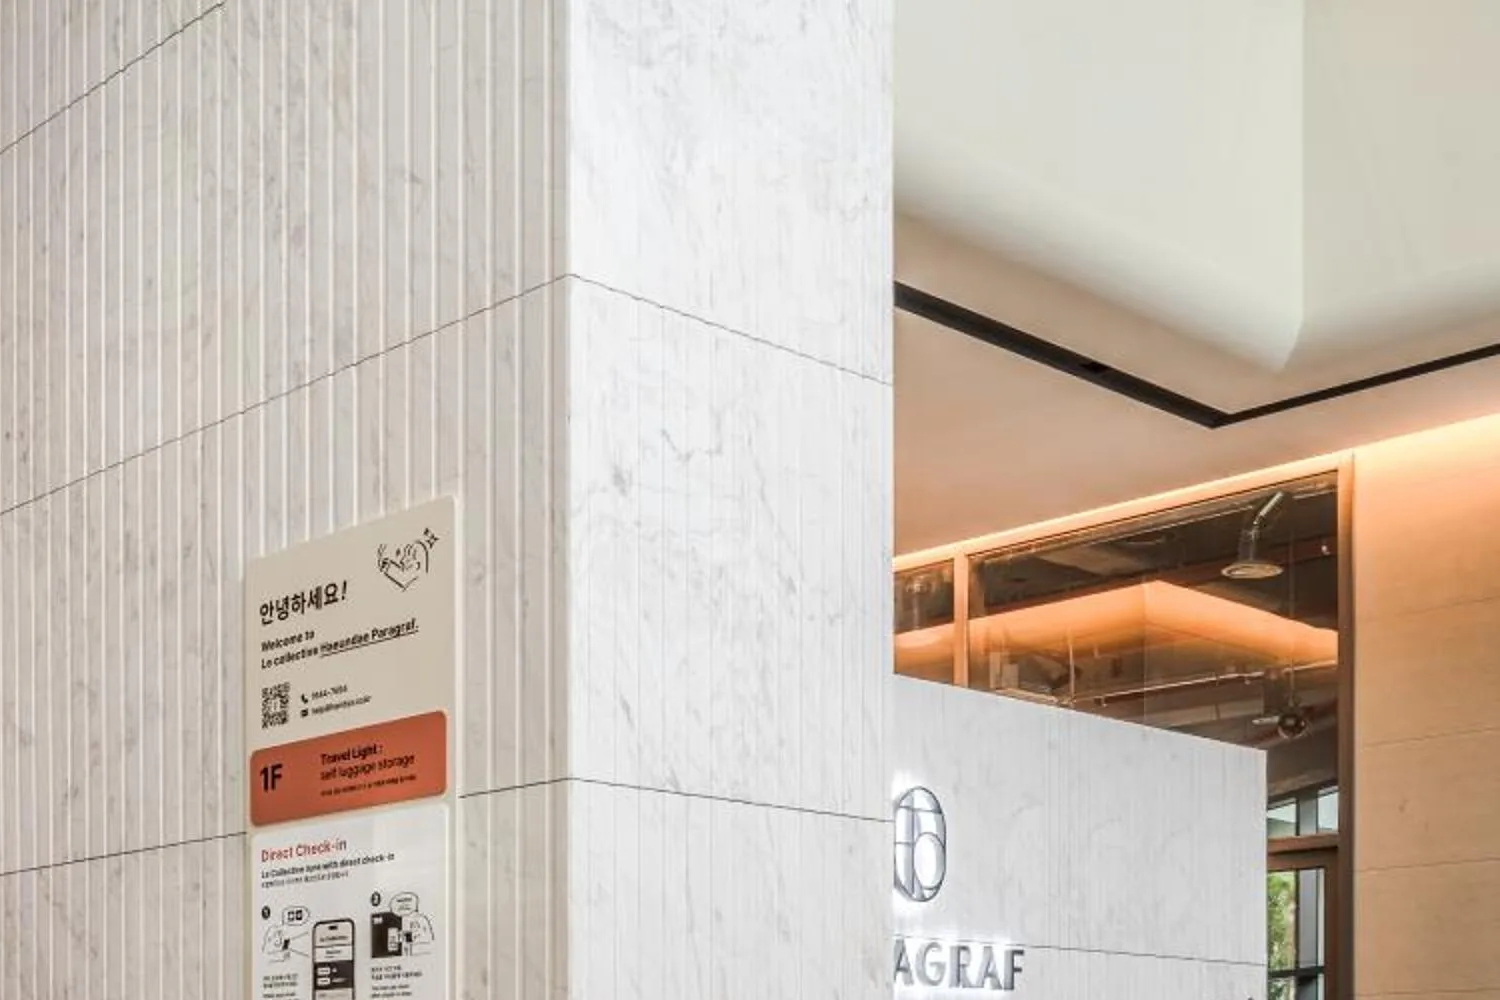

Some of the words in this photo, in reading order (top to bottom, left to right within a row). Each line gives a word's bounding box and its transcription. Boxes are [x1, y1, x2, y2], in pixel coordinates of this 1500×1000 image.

[260, 580, 347, 625] 안녕하세요!
[261, 634, 303, 651] Welcome
[305, 630, 315, 641] to
[321, 748, 351, 766] Travel
[352, 743, 377, 760] Light
[339, 760, 377, 779] luggage
[378, 754, 415, 770] storage
[260, 763, 283, 793] 1F
[261, 847, 293, 862] Direct
[296, 839, 347, 857] Check-in
[894, 938, 1024, 991] AGRAF
